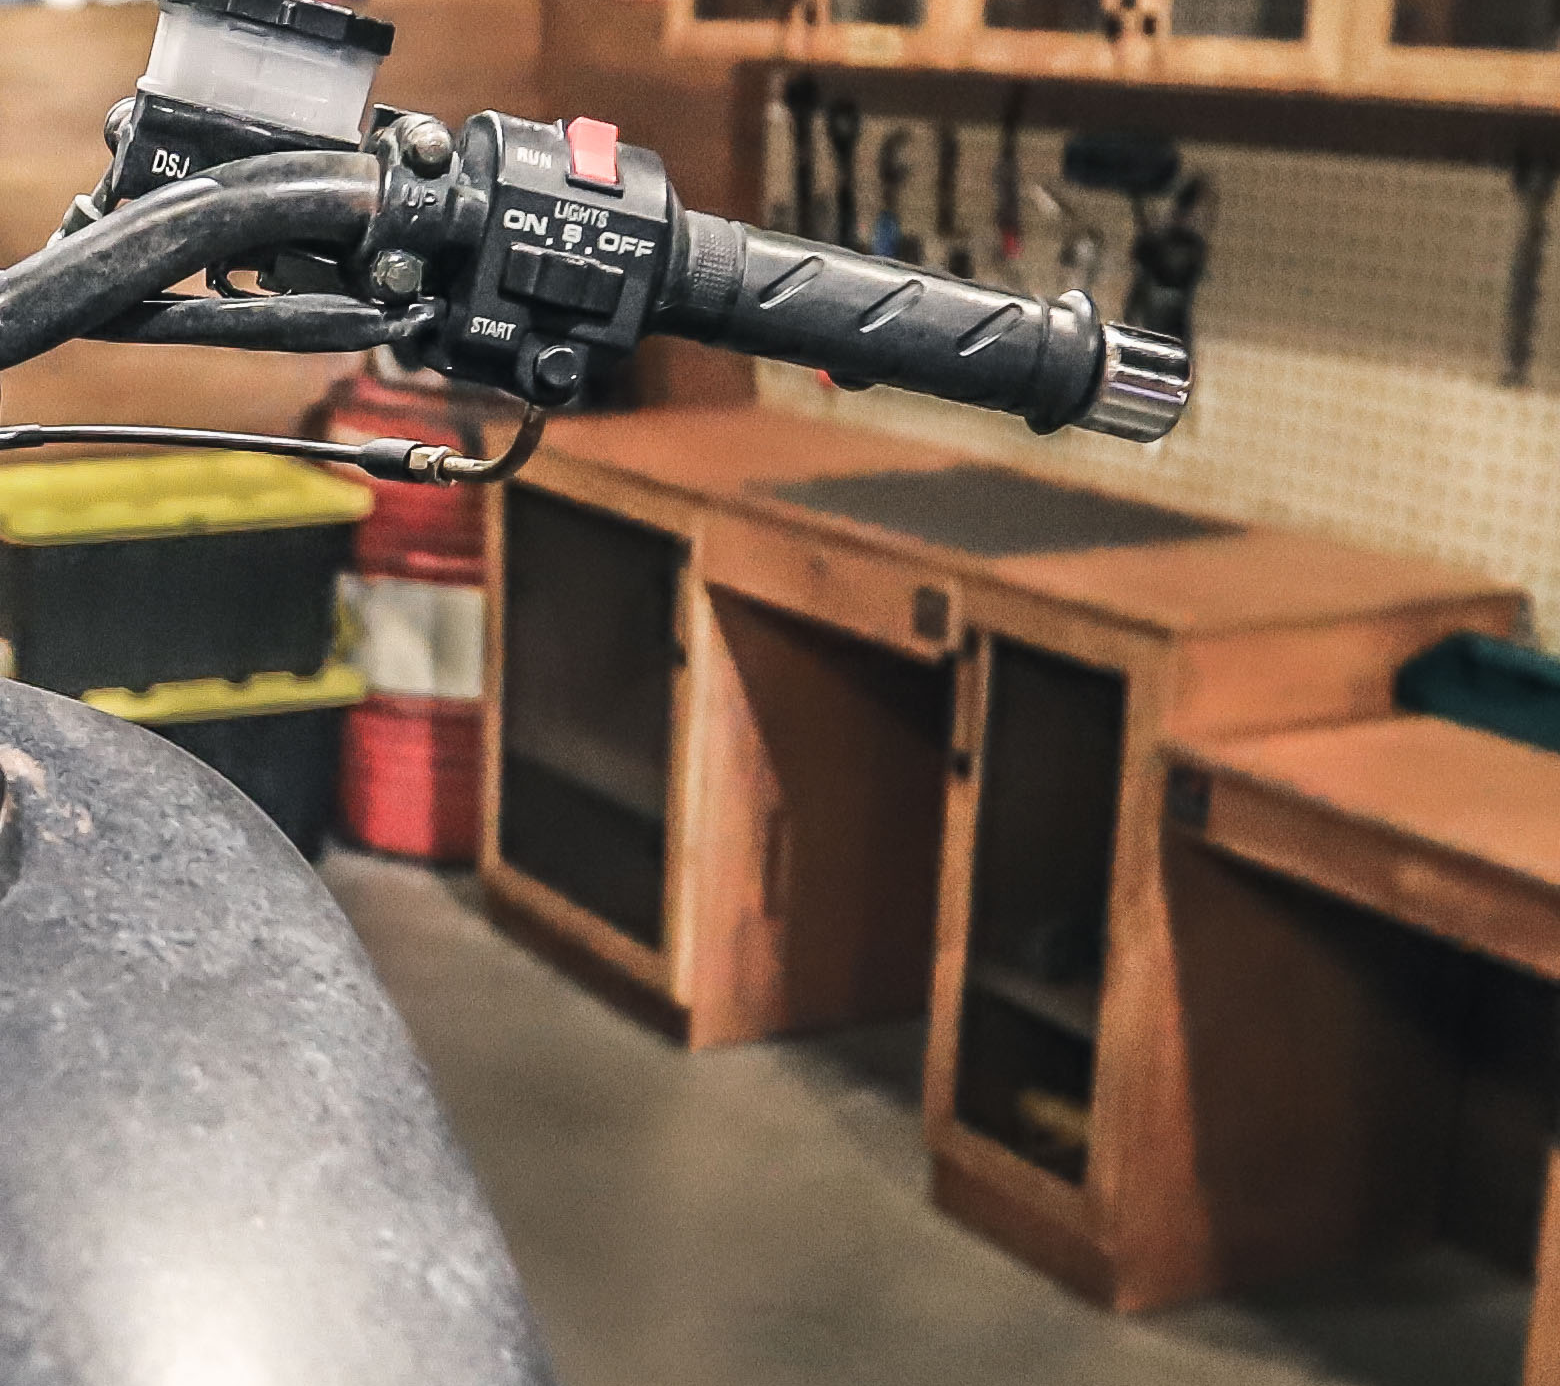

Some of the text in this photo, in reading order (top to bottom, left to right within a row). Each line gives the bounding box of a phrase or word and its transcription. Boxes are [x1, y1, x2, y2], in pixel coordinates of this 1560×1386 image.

[151, 148, 191, 179] DSJ
[517, 147, 552, 169] RUN
[554, 200, 610, 229] LIGHTS
[502, 208, 656, 258] ON OFF
[470, 317, 517, 341] START
